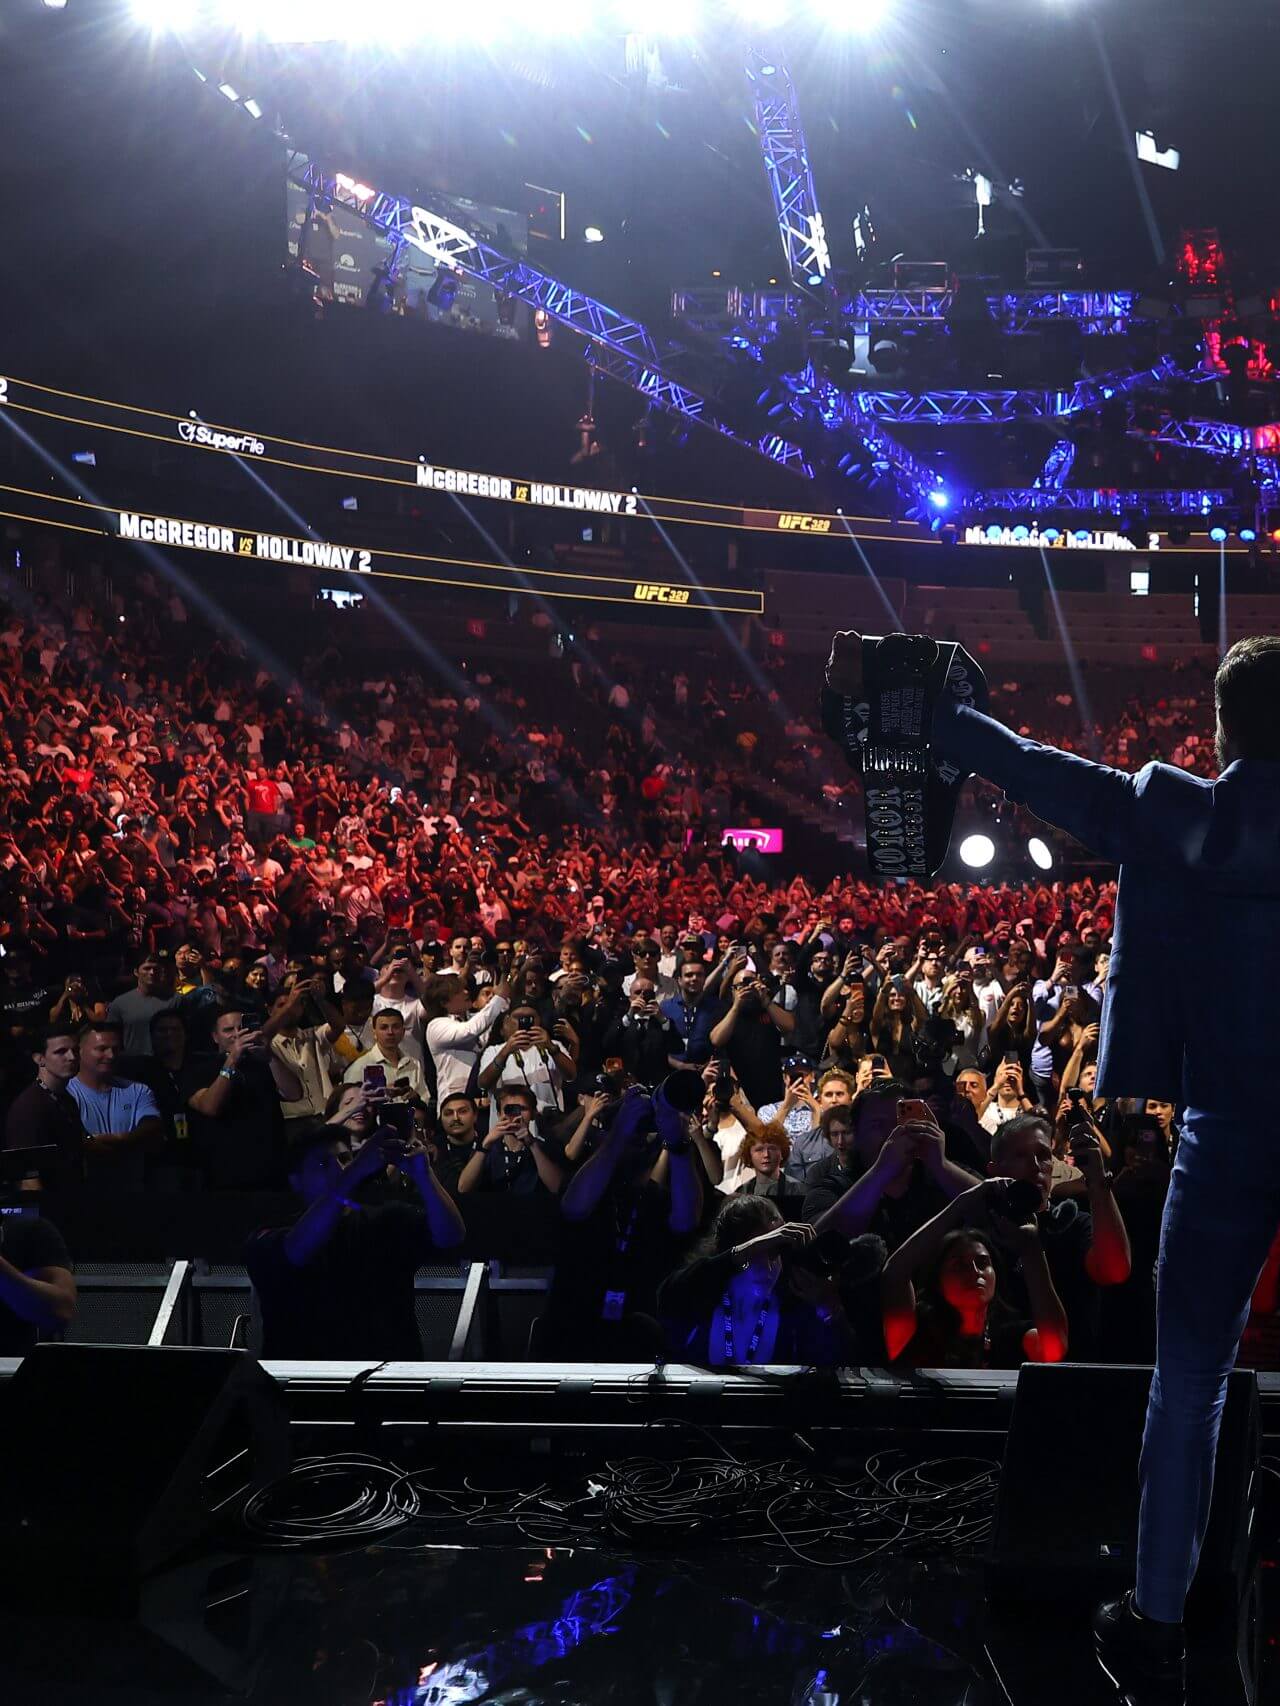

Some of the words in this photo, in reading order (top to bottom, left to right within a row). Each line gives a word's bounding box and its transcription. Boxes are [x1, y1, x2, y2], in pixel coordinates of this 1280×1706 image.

[195, 427, 265, 455] SuperFile
[417, 465, 512, 500] McGREGOR
[516, 485, 529, 501] VS
[530, 485, 621, 514] HOLLOWAY
[625, 495, 637, 514] 2
[778, 514, 811, 530] UFC
[120, 513, 233, 553] McGREGOR
[239, 536, 253, 554] VS
[256, 535, 354, 571] HOLLOWAY
[359, 551, 372, 572] 2
[1149, 533, 1160, 550] 2
[634, 585, 669, 601] UFC
